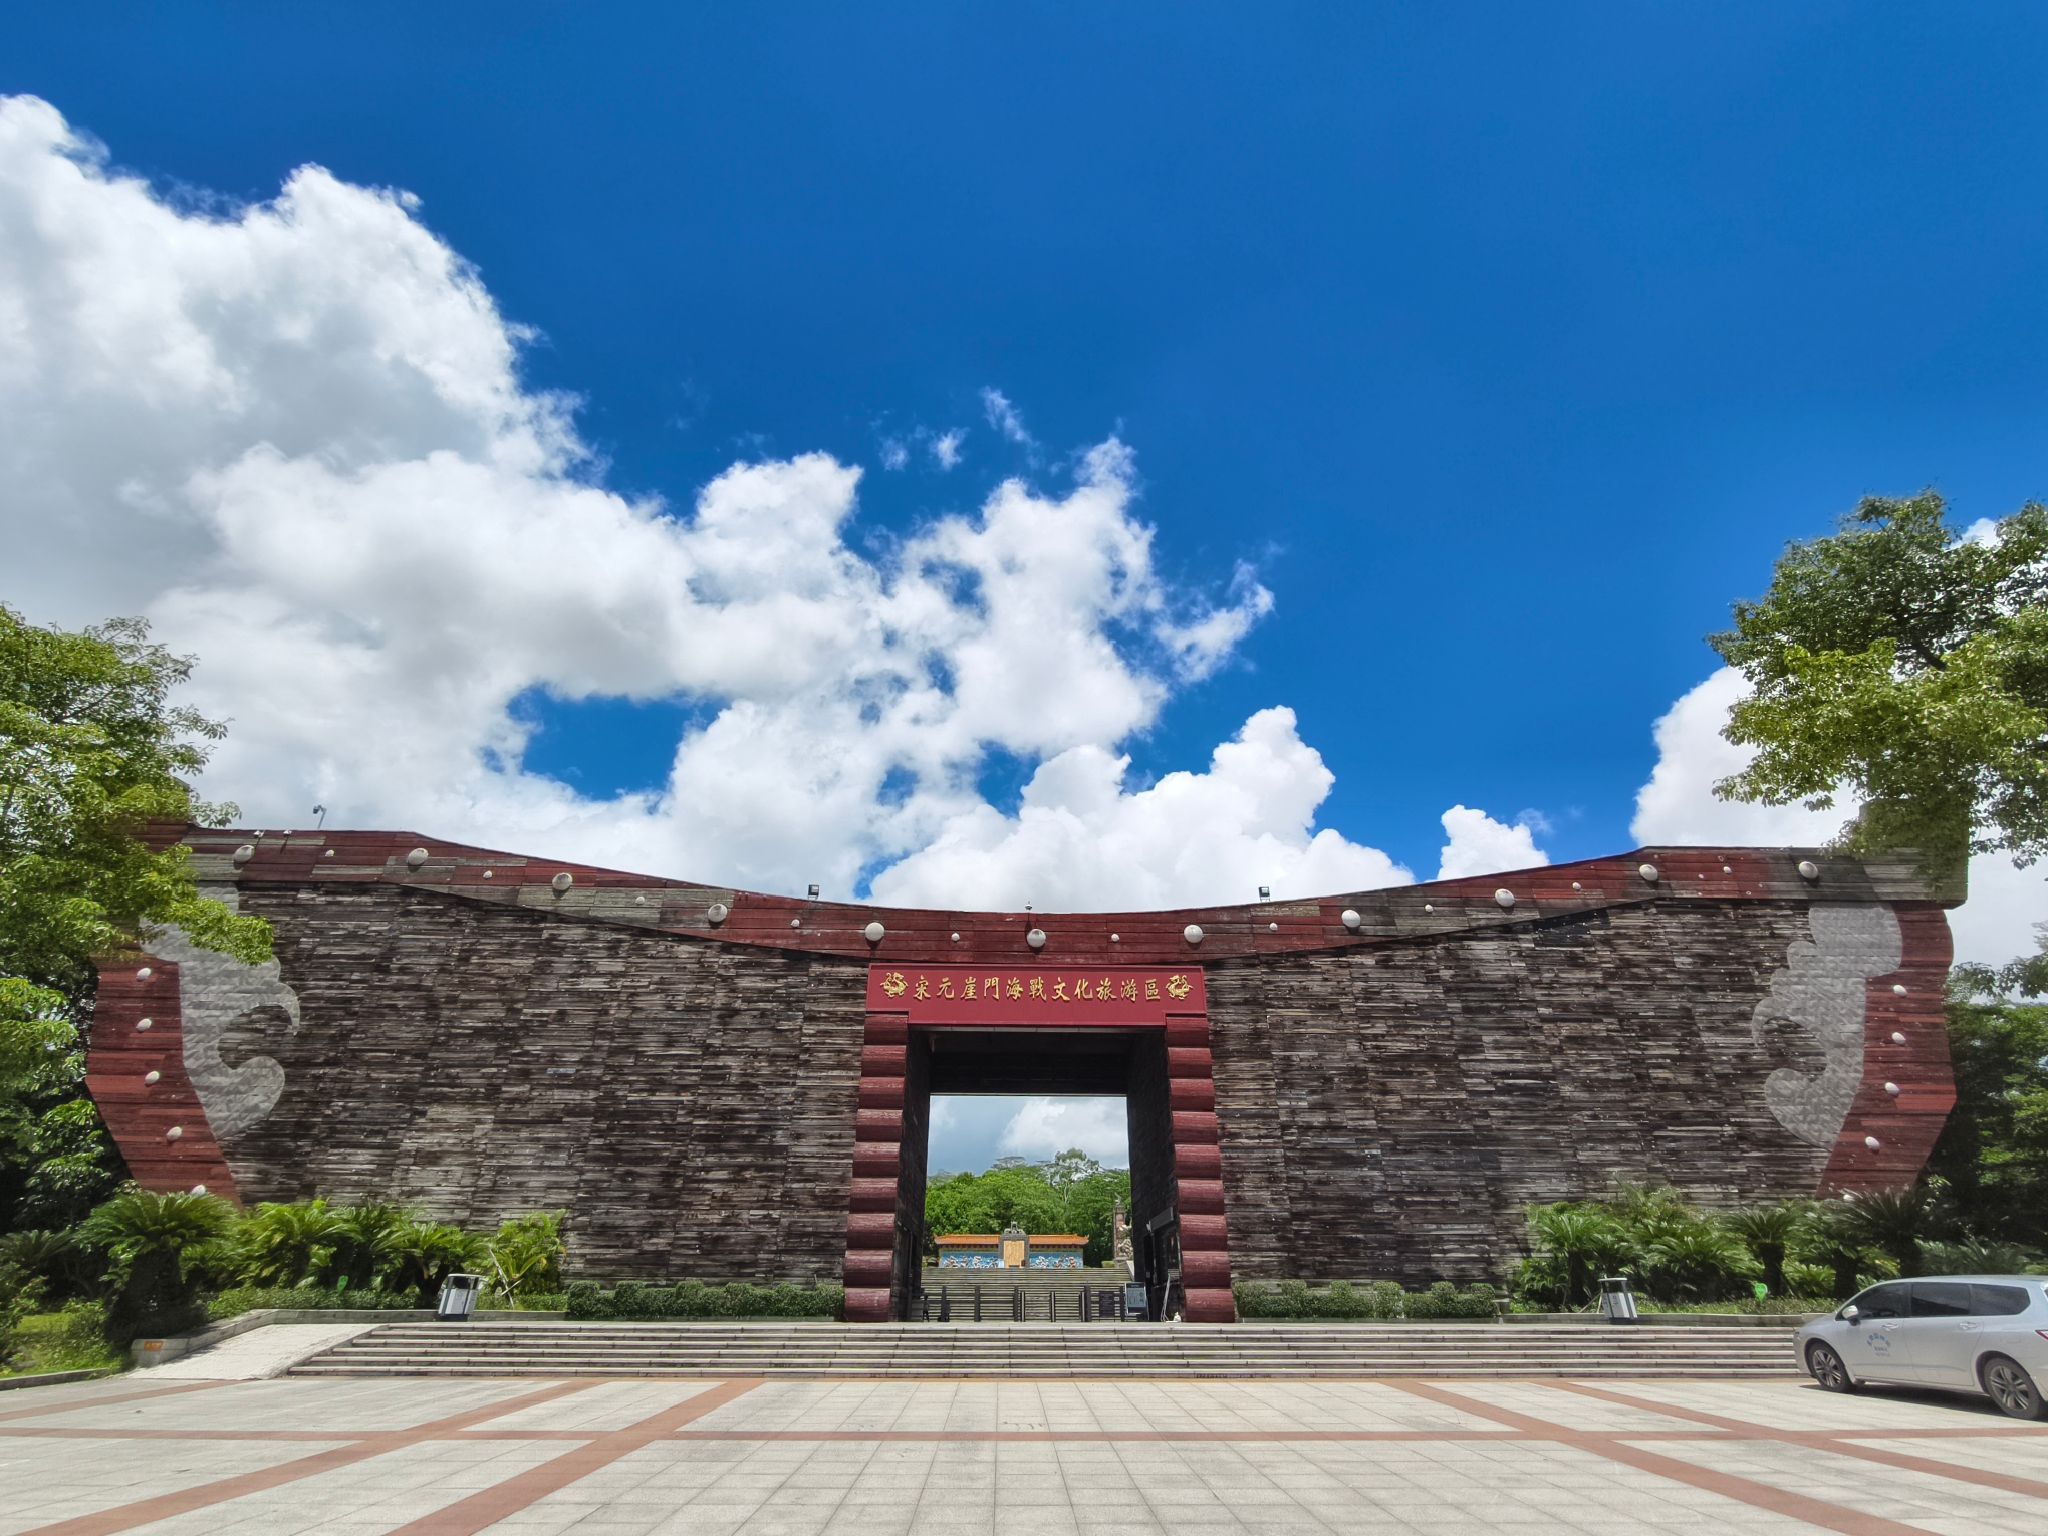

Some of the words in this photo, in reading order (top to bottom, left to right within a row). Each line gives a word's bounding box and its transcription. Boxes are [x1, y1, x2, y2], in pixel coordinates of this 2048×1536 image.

[912, 974, 1161, 1002] 宋元崖門海戰文化旅游區
